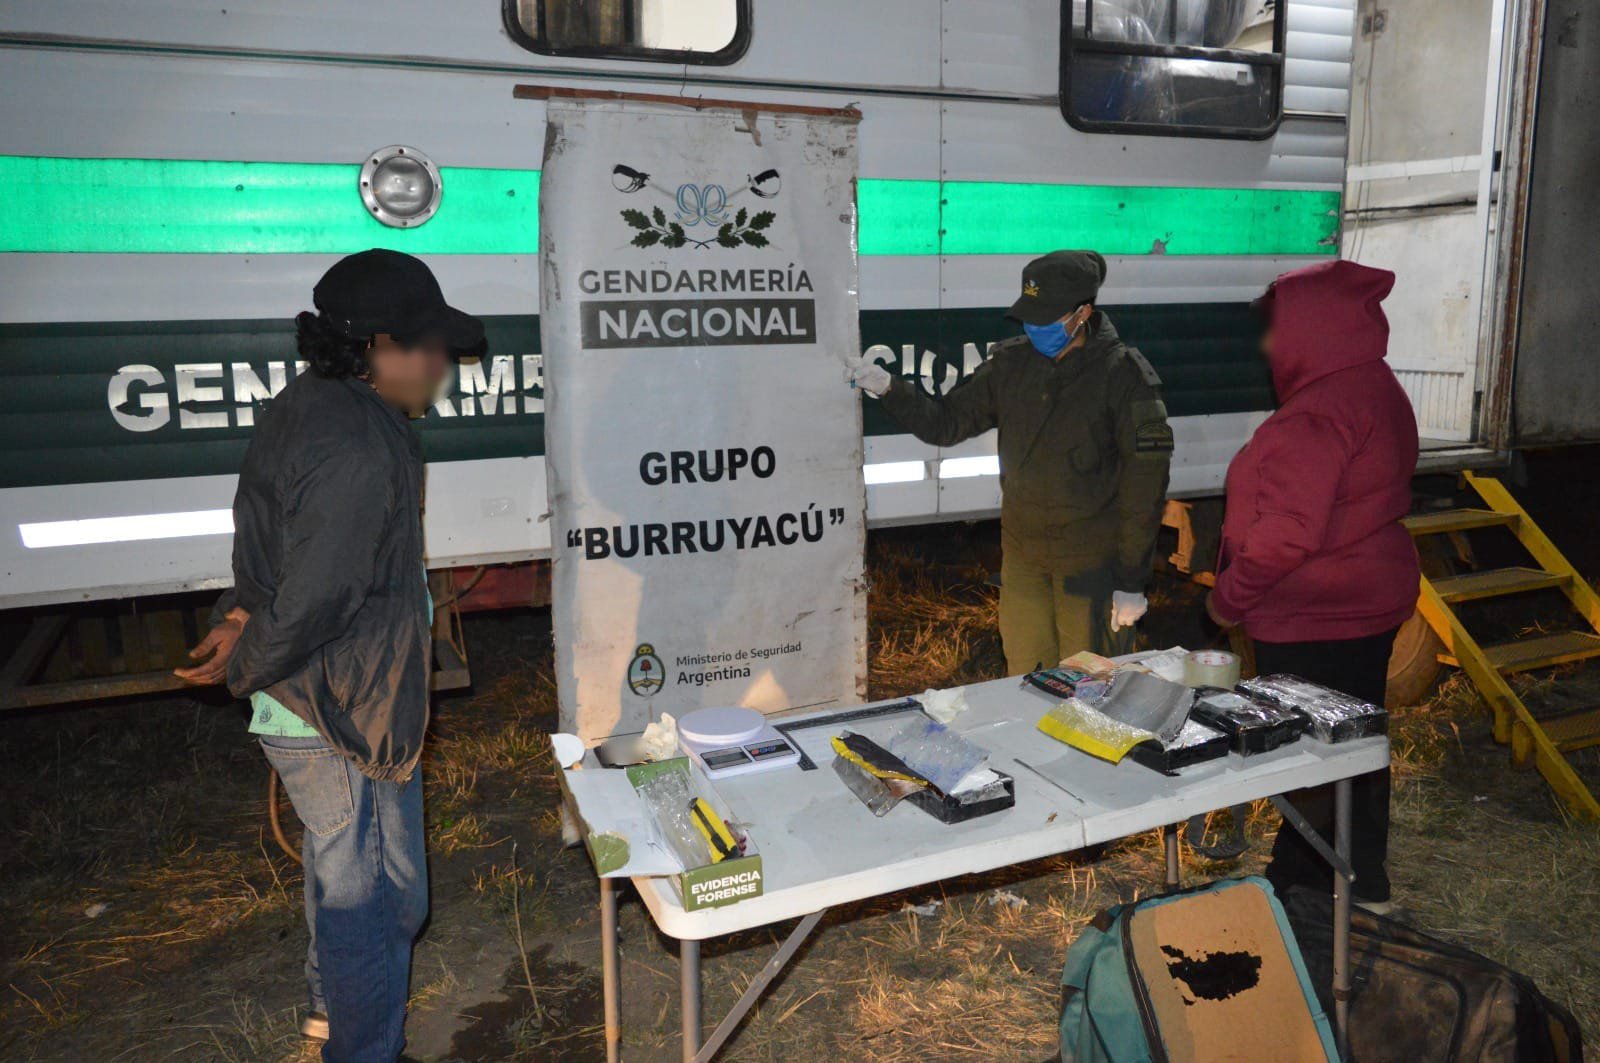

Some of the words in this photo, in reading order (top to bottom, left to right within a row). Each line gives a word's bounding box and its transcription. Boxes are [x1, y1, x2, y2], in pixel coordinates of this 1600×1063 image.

[578, 263, 814, 294] GENDARMERÍA
[599, 306, 807, 340] NACIONAL
[639, 445, 776, 485] GRUPO
[676, 652, 732, 667] Ministerio
[735, 650, 749, 661] de
[751, 641, 802, 660] Seguridad
[677, 665, 751, 686] Argentina
[691, 870, 761, 894] EVIDENCIA
[697, 882, 757, 905] FORENSE
